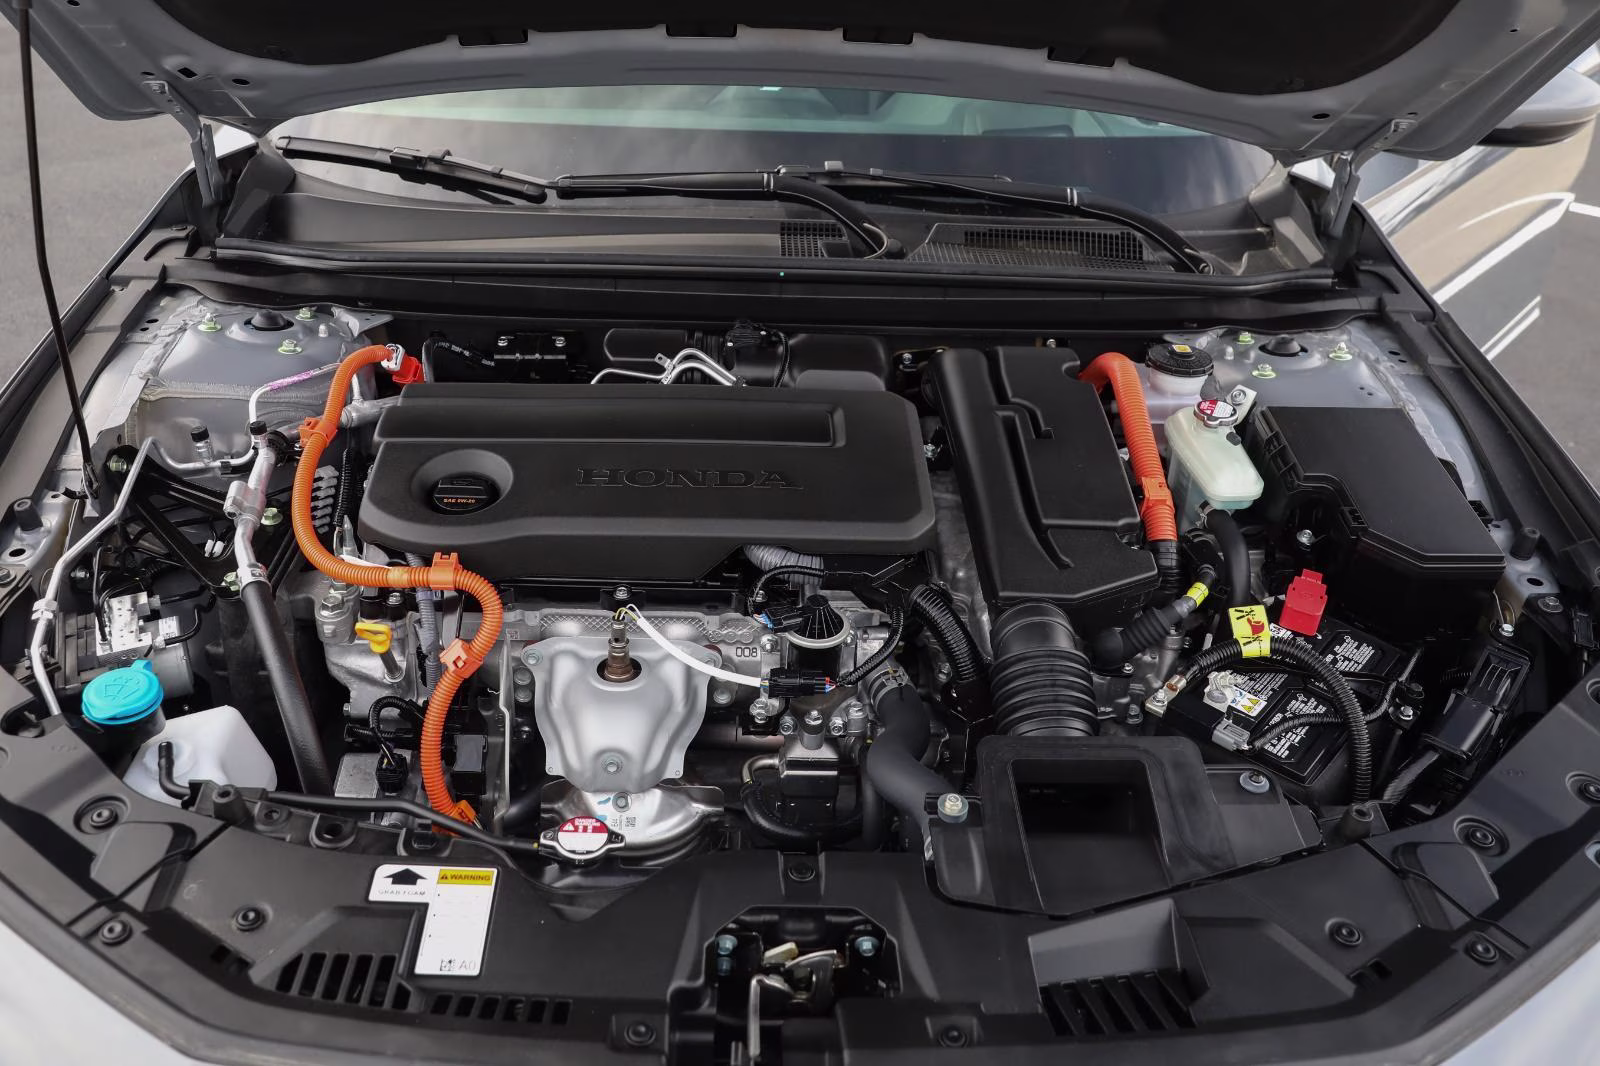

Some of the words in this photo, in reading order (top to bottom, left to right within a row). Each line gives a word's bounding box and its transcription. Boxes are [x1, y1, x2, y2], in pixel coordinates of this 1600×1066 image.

[576, 468, 804, 490] HONDA
[735, 646, 758, 658] 008
[450, 873, 491, 881] WARNING
